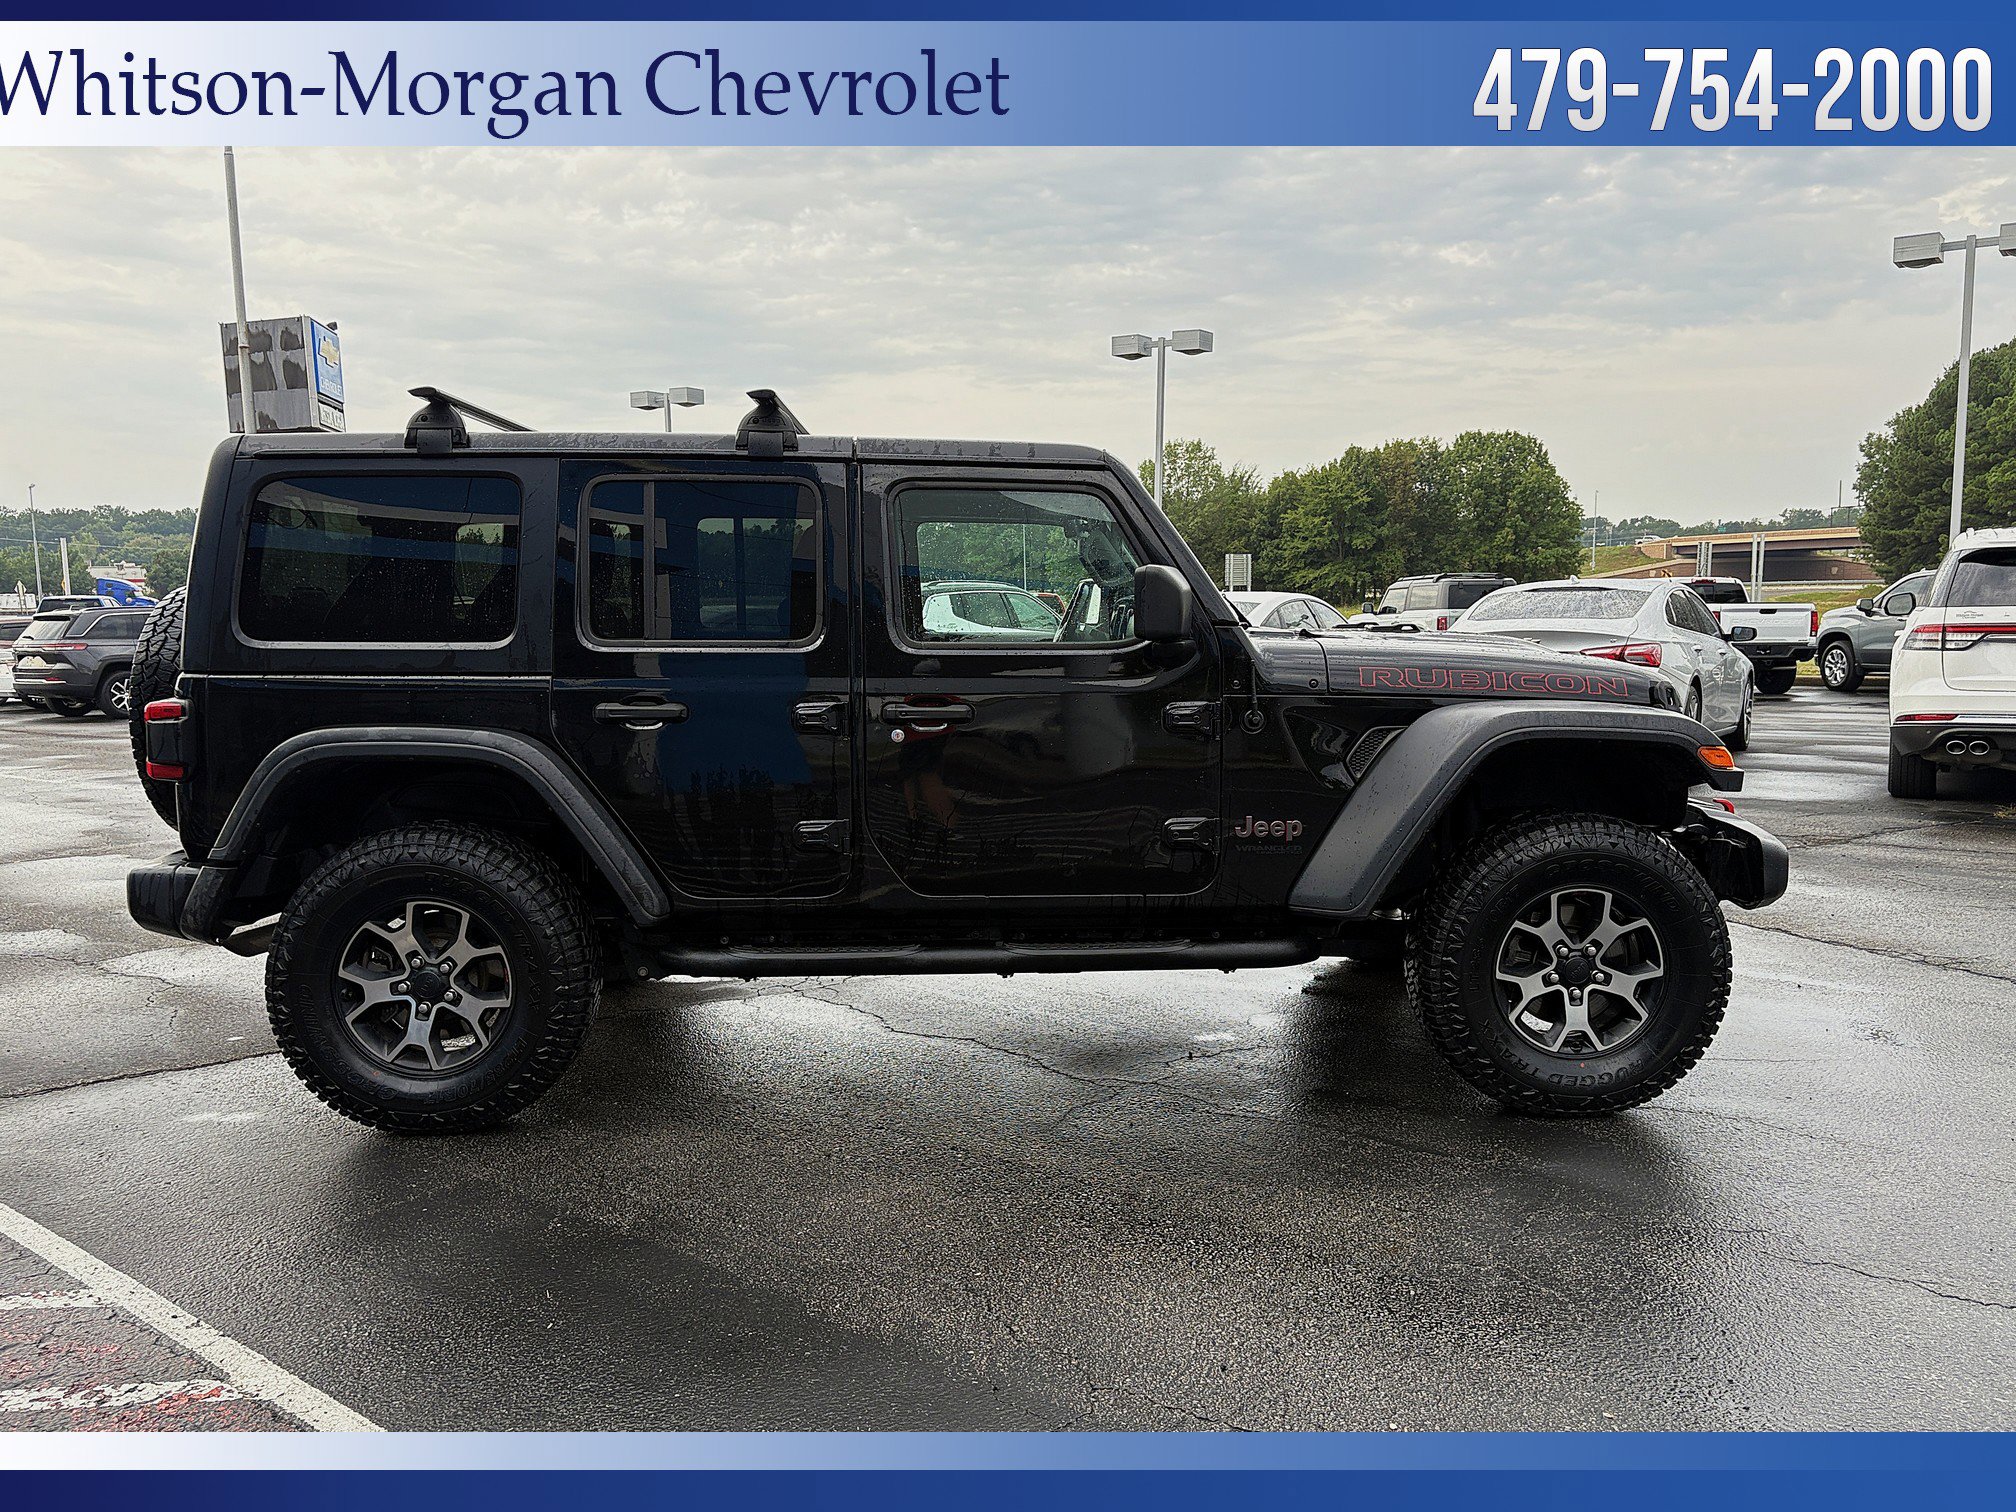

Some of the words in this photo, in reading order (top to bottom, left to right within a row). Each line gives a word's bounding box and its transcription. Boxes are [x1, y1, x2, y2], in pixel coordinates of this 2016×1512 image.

[1359, 667, 1628, 696] RUBICON
[1234, 815, 1302, 842] Jeep
[1474, 1017, 1541, 1080] TRAXX
[1546, 1055, 1646, 1089] RUGGED
